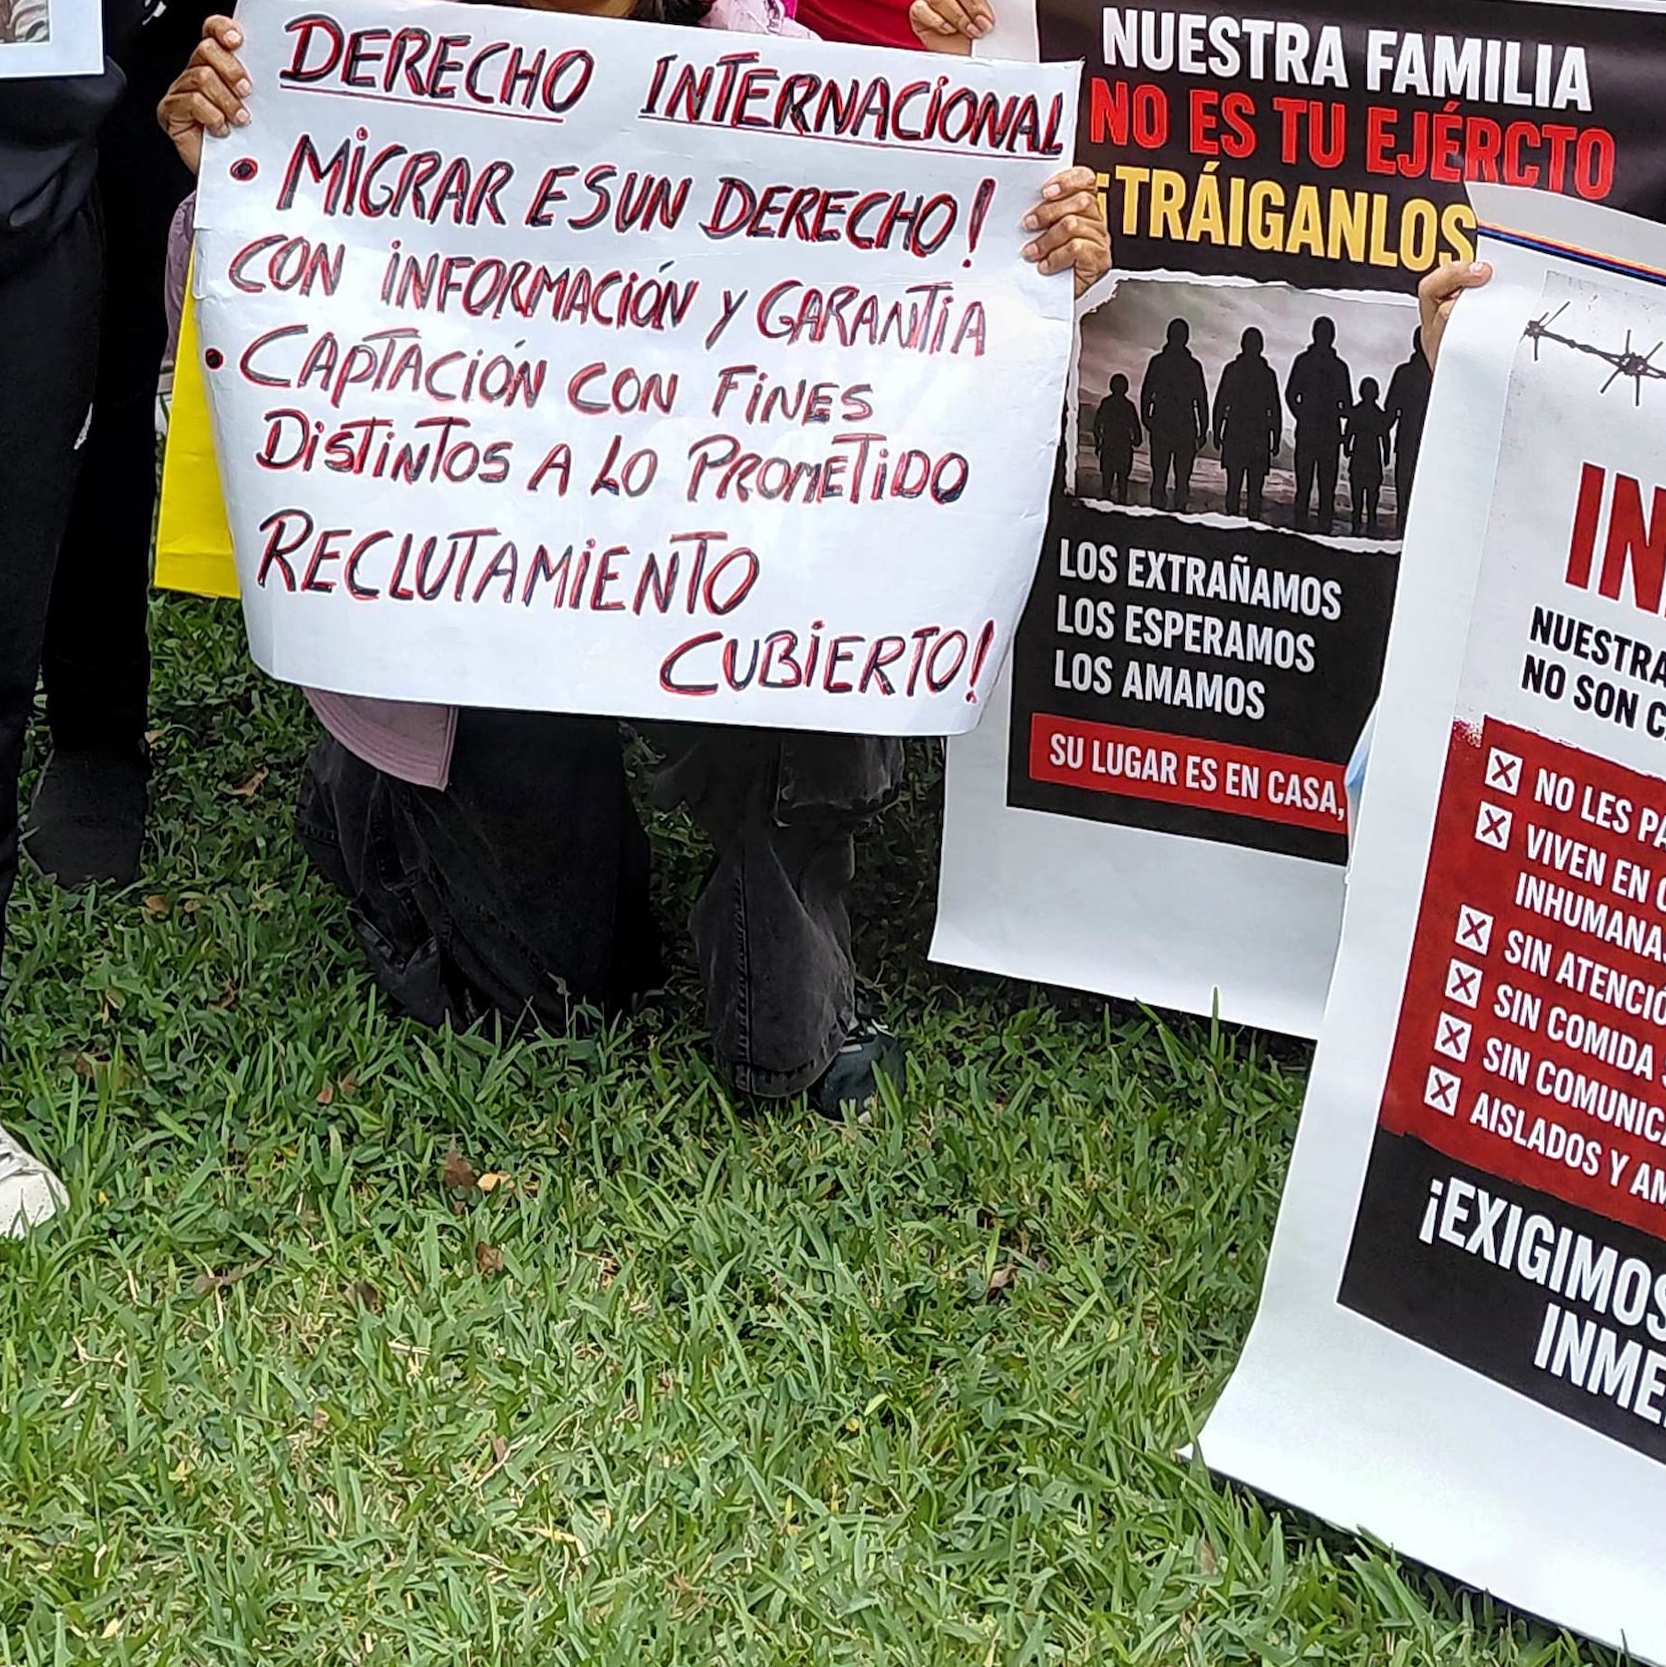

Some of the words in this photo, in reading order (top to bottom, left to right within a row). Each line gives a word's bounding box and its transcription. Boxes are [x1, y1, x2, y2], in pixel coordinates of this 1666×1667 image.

[279, 14, 595, 112] DERECHO
[1102, 7, 1349, 89] NUESTRA
[1365, 29, 1592, 111] FAMILIA
[1089, 77, 1169, 149] NO
[1189, 88, 1256, 158] ES
[1273, 95, 1345, 169] TU
[1365, 101, 1616, 201] EJÉRCTO
[698, 177, 998, 270] DERECHO!
[229, 233, 341, 306] CON
[567, 364, 679, 416] CON
[527, 444, 572, 496] A
[591, 436, 659, 498] LO
[1059, 538, 1117, 584] LOS
[1127, 548, 1342, 620] EXTRAÑAMOS
[1057, 595, 1115, 640] LOS
[1125, 605, 1316, 673] ESPERAMOS
[1054, 649, 1113, 694] LOS
[1121, 660, 1265, 720] AMAMOS
[1521, 655, 1564, 701] NO
[1573, 674, 1638, 729] SON
[1049, 733, 1083, 769] SU
[1091, 737, 1176, 784] LUGAR
[1186, 754, 1218, 792] ES
[1226, 762, 1259, 799] EN
[1268, 770, 1345, 821] CASA,
[1534, 769, 1575, 813] NO
[1580, 785, 1633, 835] LES
[1525, 824, 1605, 885] VIVEN
[1611, 863, 1649, 903] EN
[1504, 929, 1551, 978] SIN
[1483, 1038, 1531, 1086] SIN
[1493, 984, 1541, 1031] SIN
[1546, 1005, 1654, 1080] COMIDA
[1470, 1091, 1603, 1178] AISLADOS
[1609, 1150, 1630, 1187] Y
